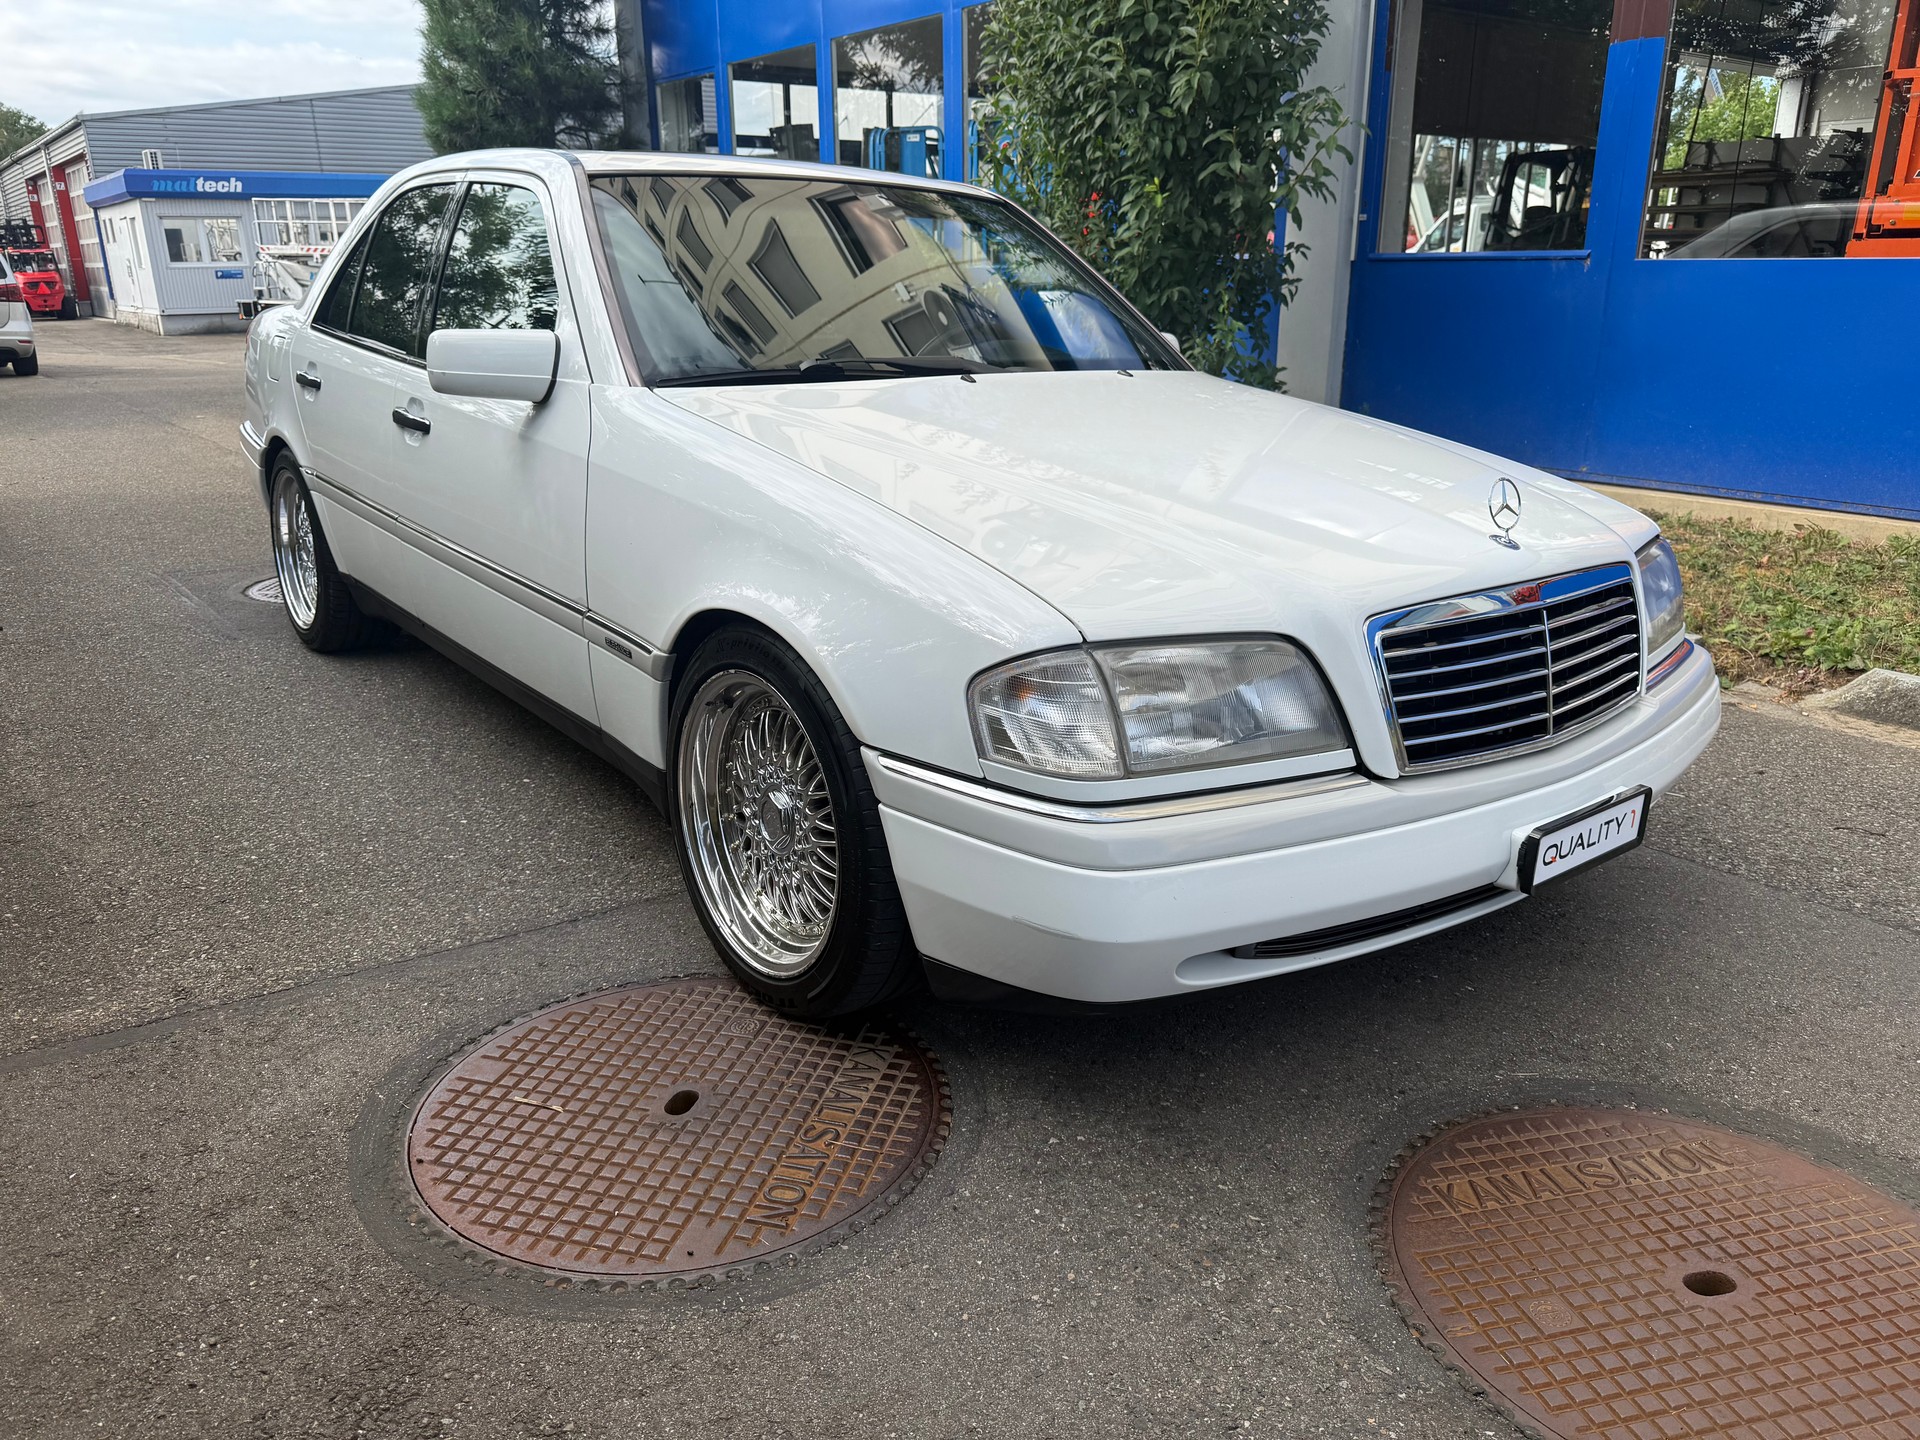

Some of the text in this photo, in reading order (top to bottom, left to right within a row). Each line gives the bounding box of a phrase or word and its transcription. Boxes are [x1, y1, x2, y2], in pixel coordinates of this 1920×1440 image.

[151, 177, 242, 192] maltech
[1543, 812, 1628, 866] QUALITY
[746, 1046, 891, 1229] KANALISATION
[1432, 1140, 1735, 1213] KANALISATION
